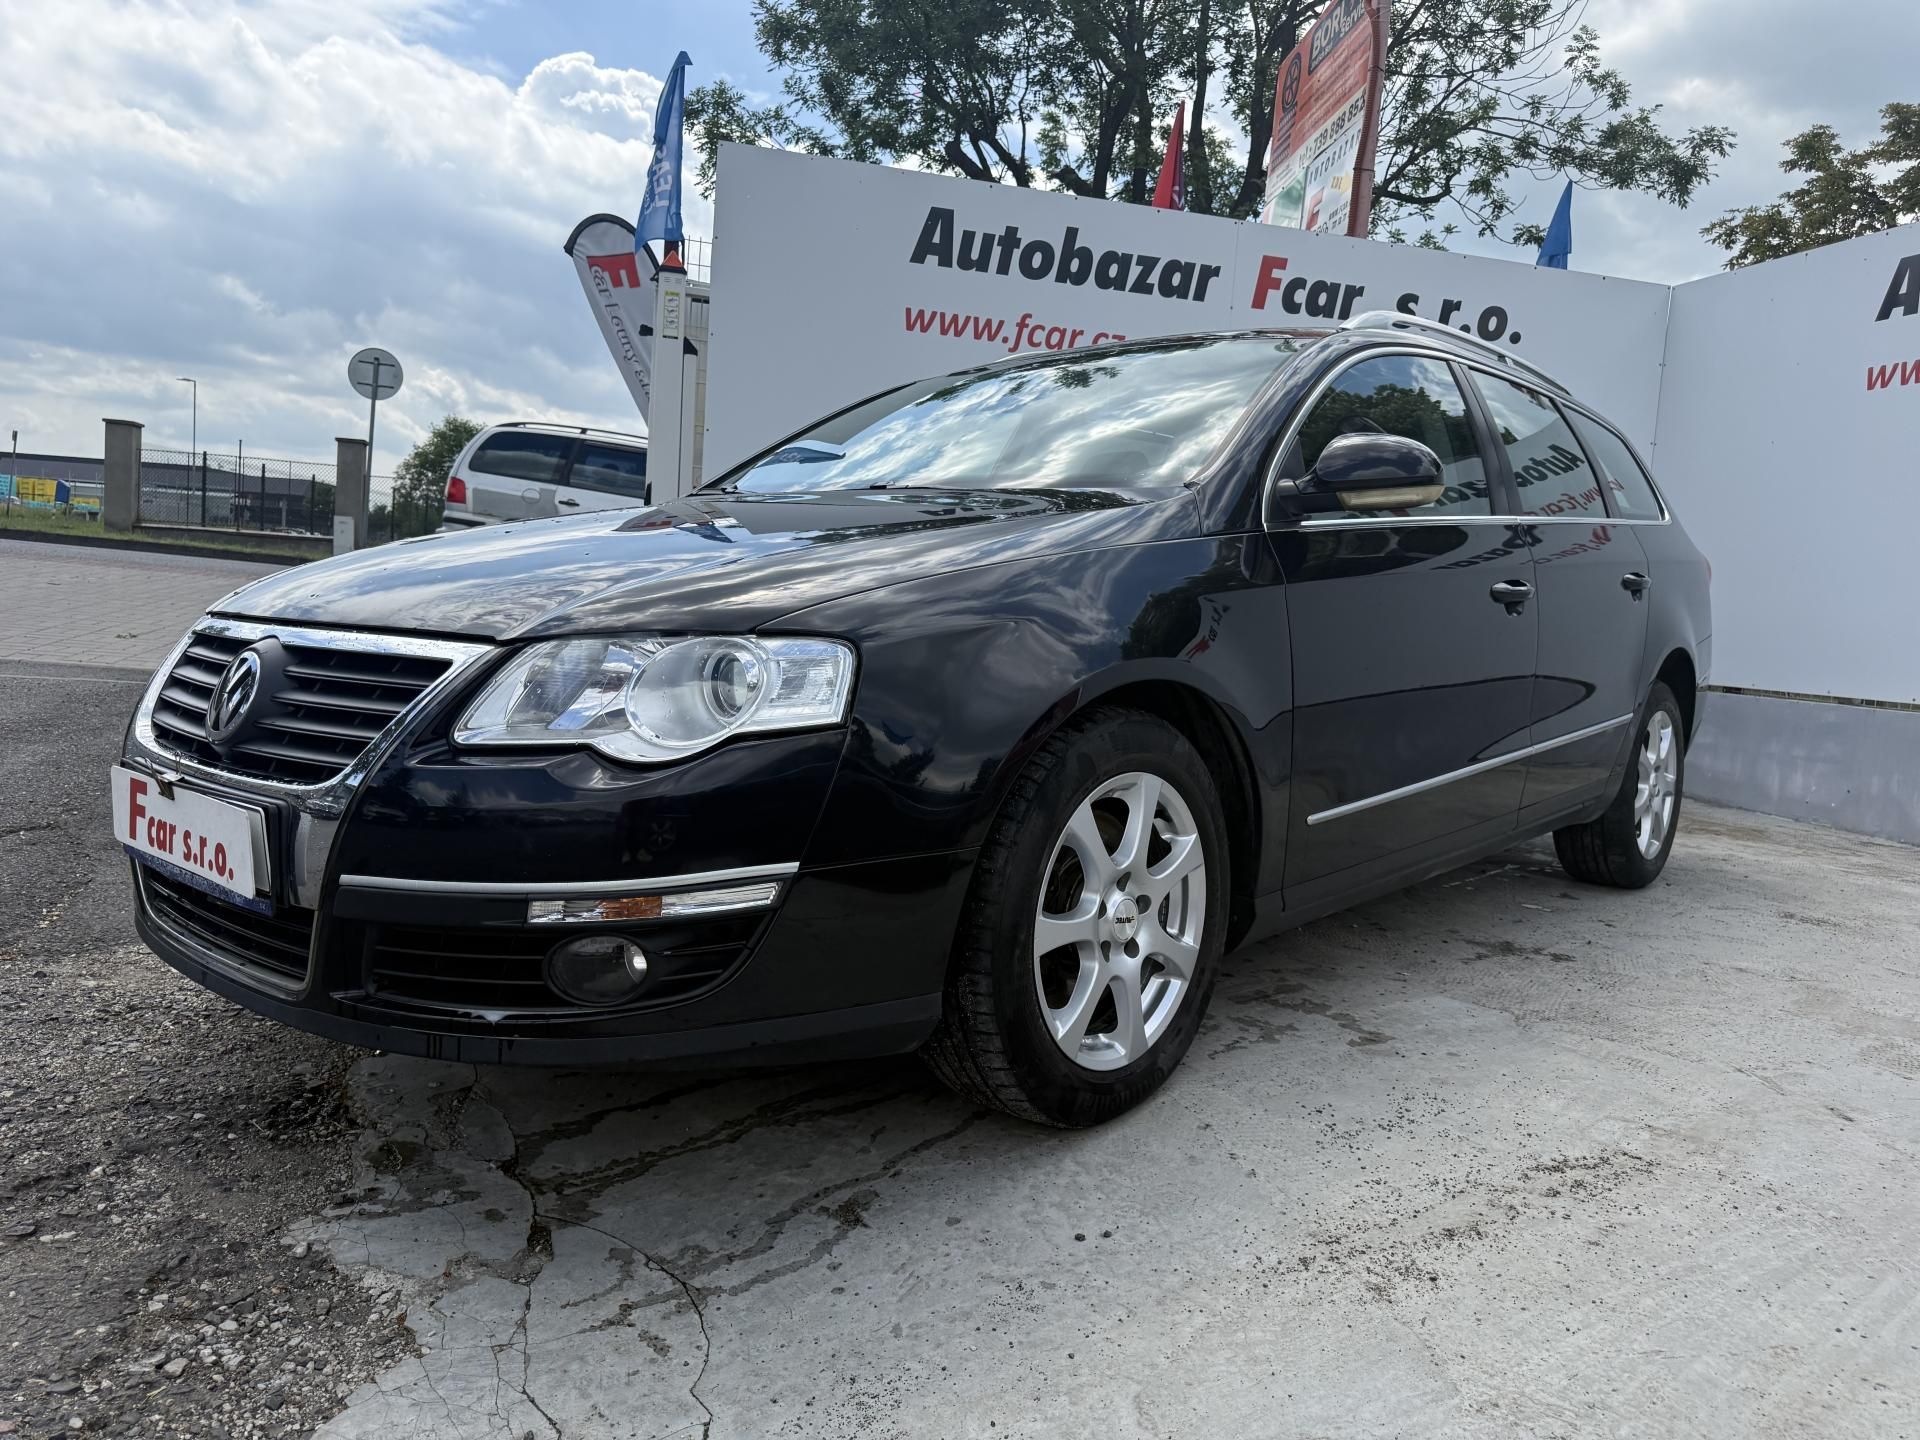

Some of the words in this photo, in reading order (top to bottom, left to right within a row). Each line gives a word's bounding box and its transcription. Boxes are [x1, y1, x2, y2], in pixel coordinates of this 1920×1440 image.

[909, 206, 1222, 302] Autobazar
[1251, 255, 1365, 321] Fcar
[183, 829, 234, 881] s.r.o.
